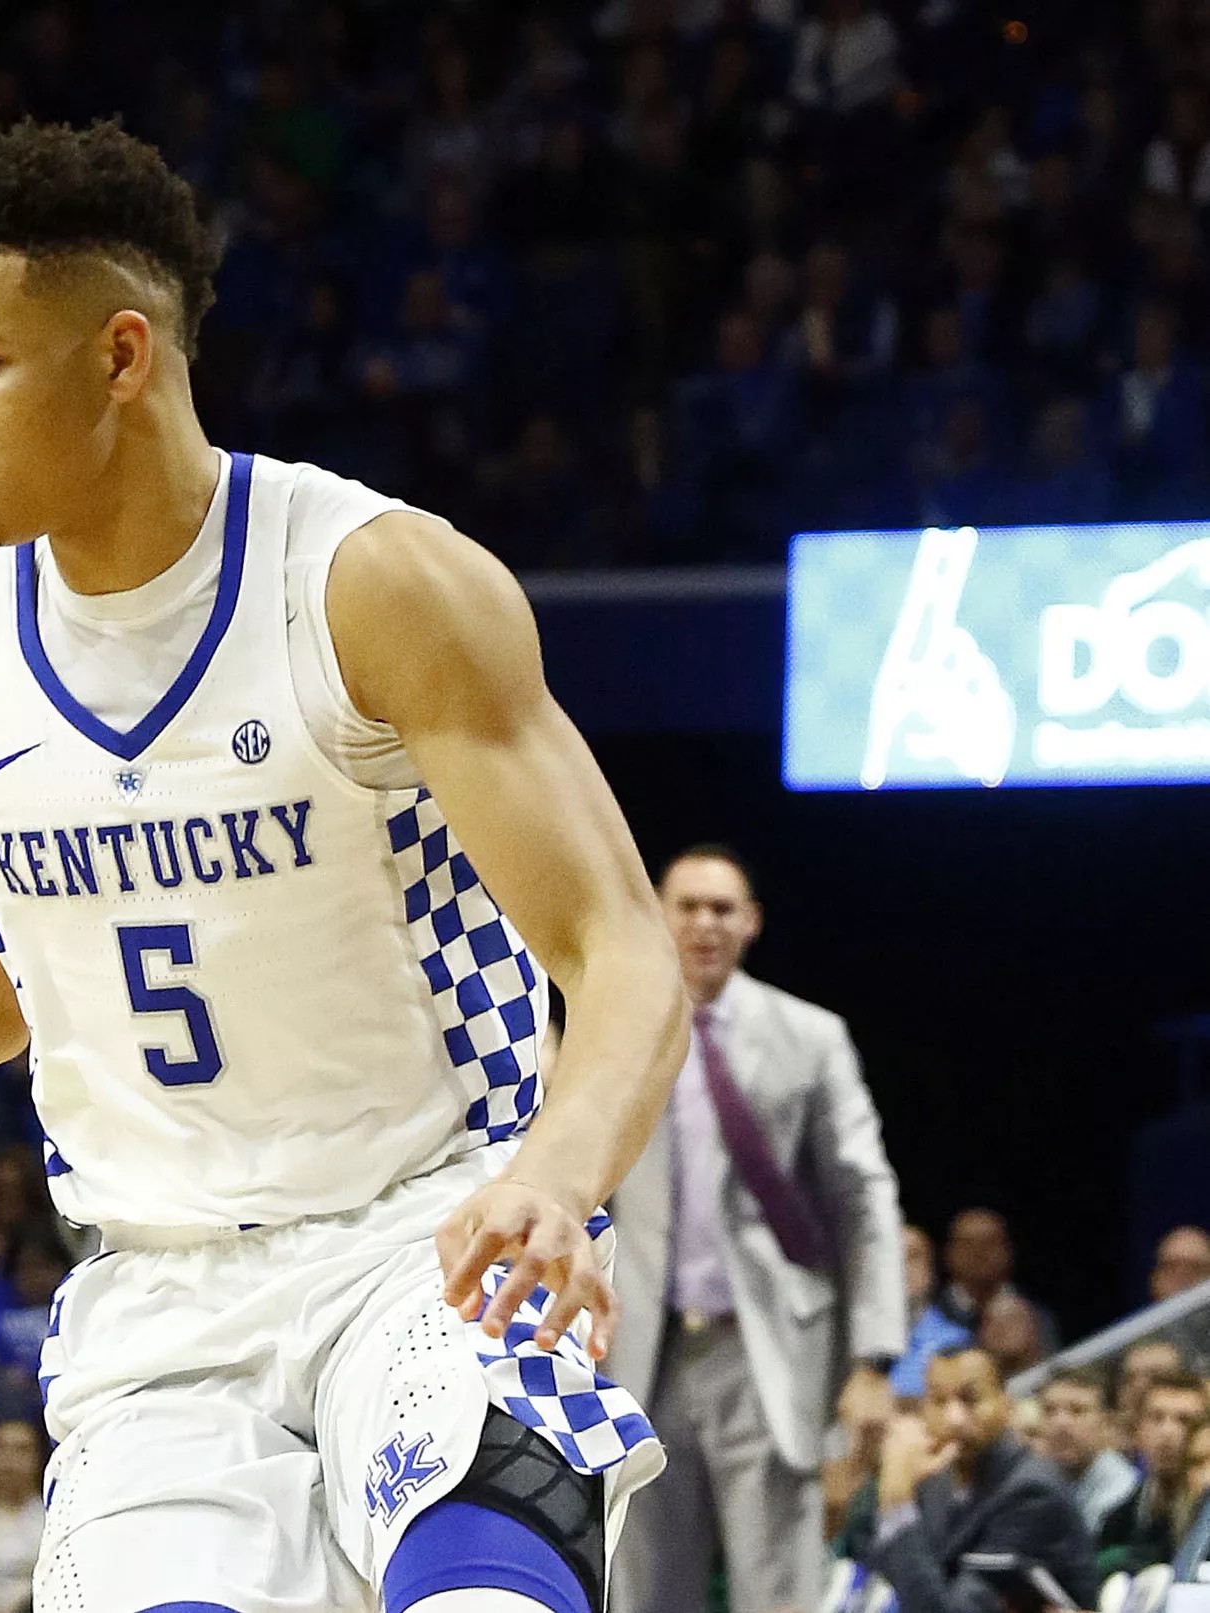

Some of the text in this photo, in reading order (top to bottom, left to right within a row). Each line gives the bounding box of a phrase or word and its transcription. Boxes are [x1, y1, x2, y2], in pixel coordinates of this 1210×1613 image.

[1037, 602, 1210, 716] DO
[232, 720, 270, 764] SEC
[114, 919, 227, 1089] 5
[364, 1430, 448, 1529] UK
